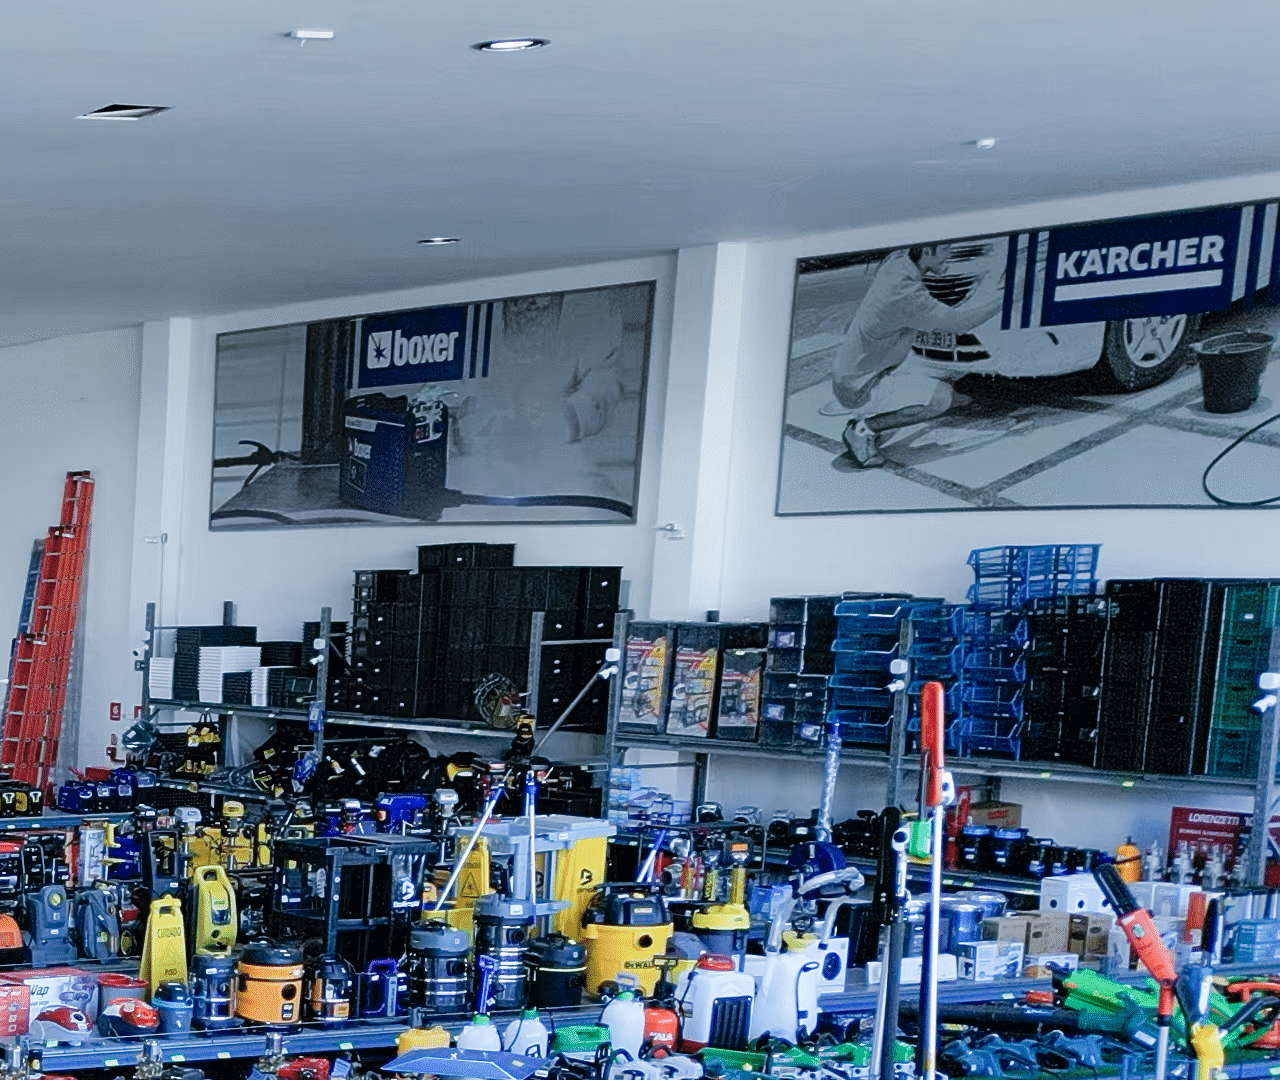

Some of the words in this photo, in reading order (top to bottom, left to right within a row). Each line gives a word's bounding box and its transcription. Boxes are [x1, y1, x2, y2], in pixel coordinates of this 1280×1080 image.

[1055, 234, 1225, 279] KÄRCHER
[393, 329, 460, 366] boxer
[1188, 813, 1240, 825] LORENZETTI
[624, 961, 654, 970] DEWAL
